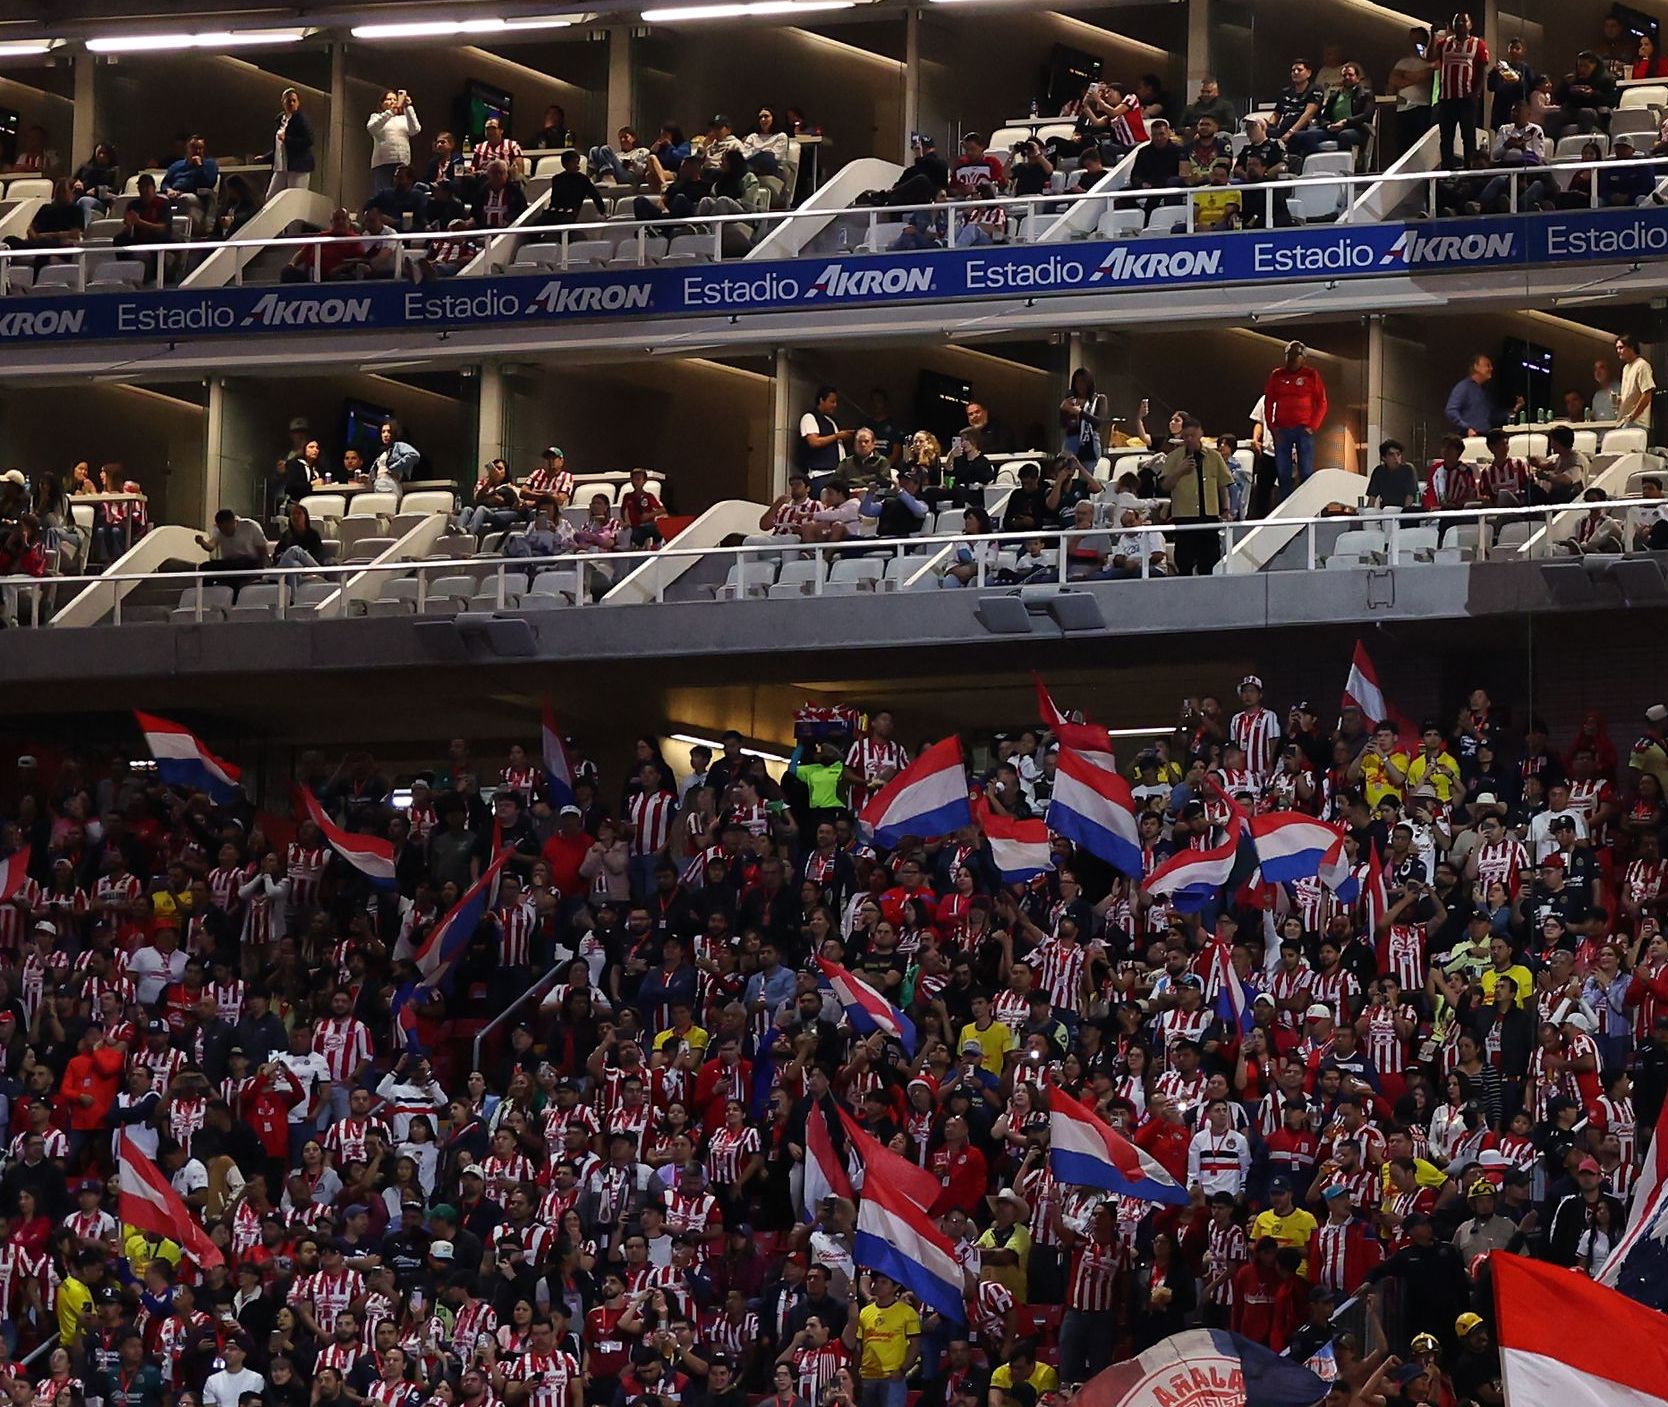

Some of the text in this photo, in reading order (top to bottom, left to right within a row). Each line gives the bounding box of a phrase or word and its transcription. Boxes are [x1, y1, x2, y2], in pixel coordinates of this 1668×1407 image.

[1254, 230, 1513, 272] Estadio AKRON
[1548, 222, 1667, 255] Estadio
[683, 264, 934, 306] Estadio AKRON
[966, 248, 1223, 290] Estadio AKRON
[118, 294, 372, 331] Estadio AKRON
[405, 281, 652, 320] Estadio AKRON
